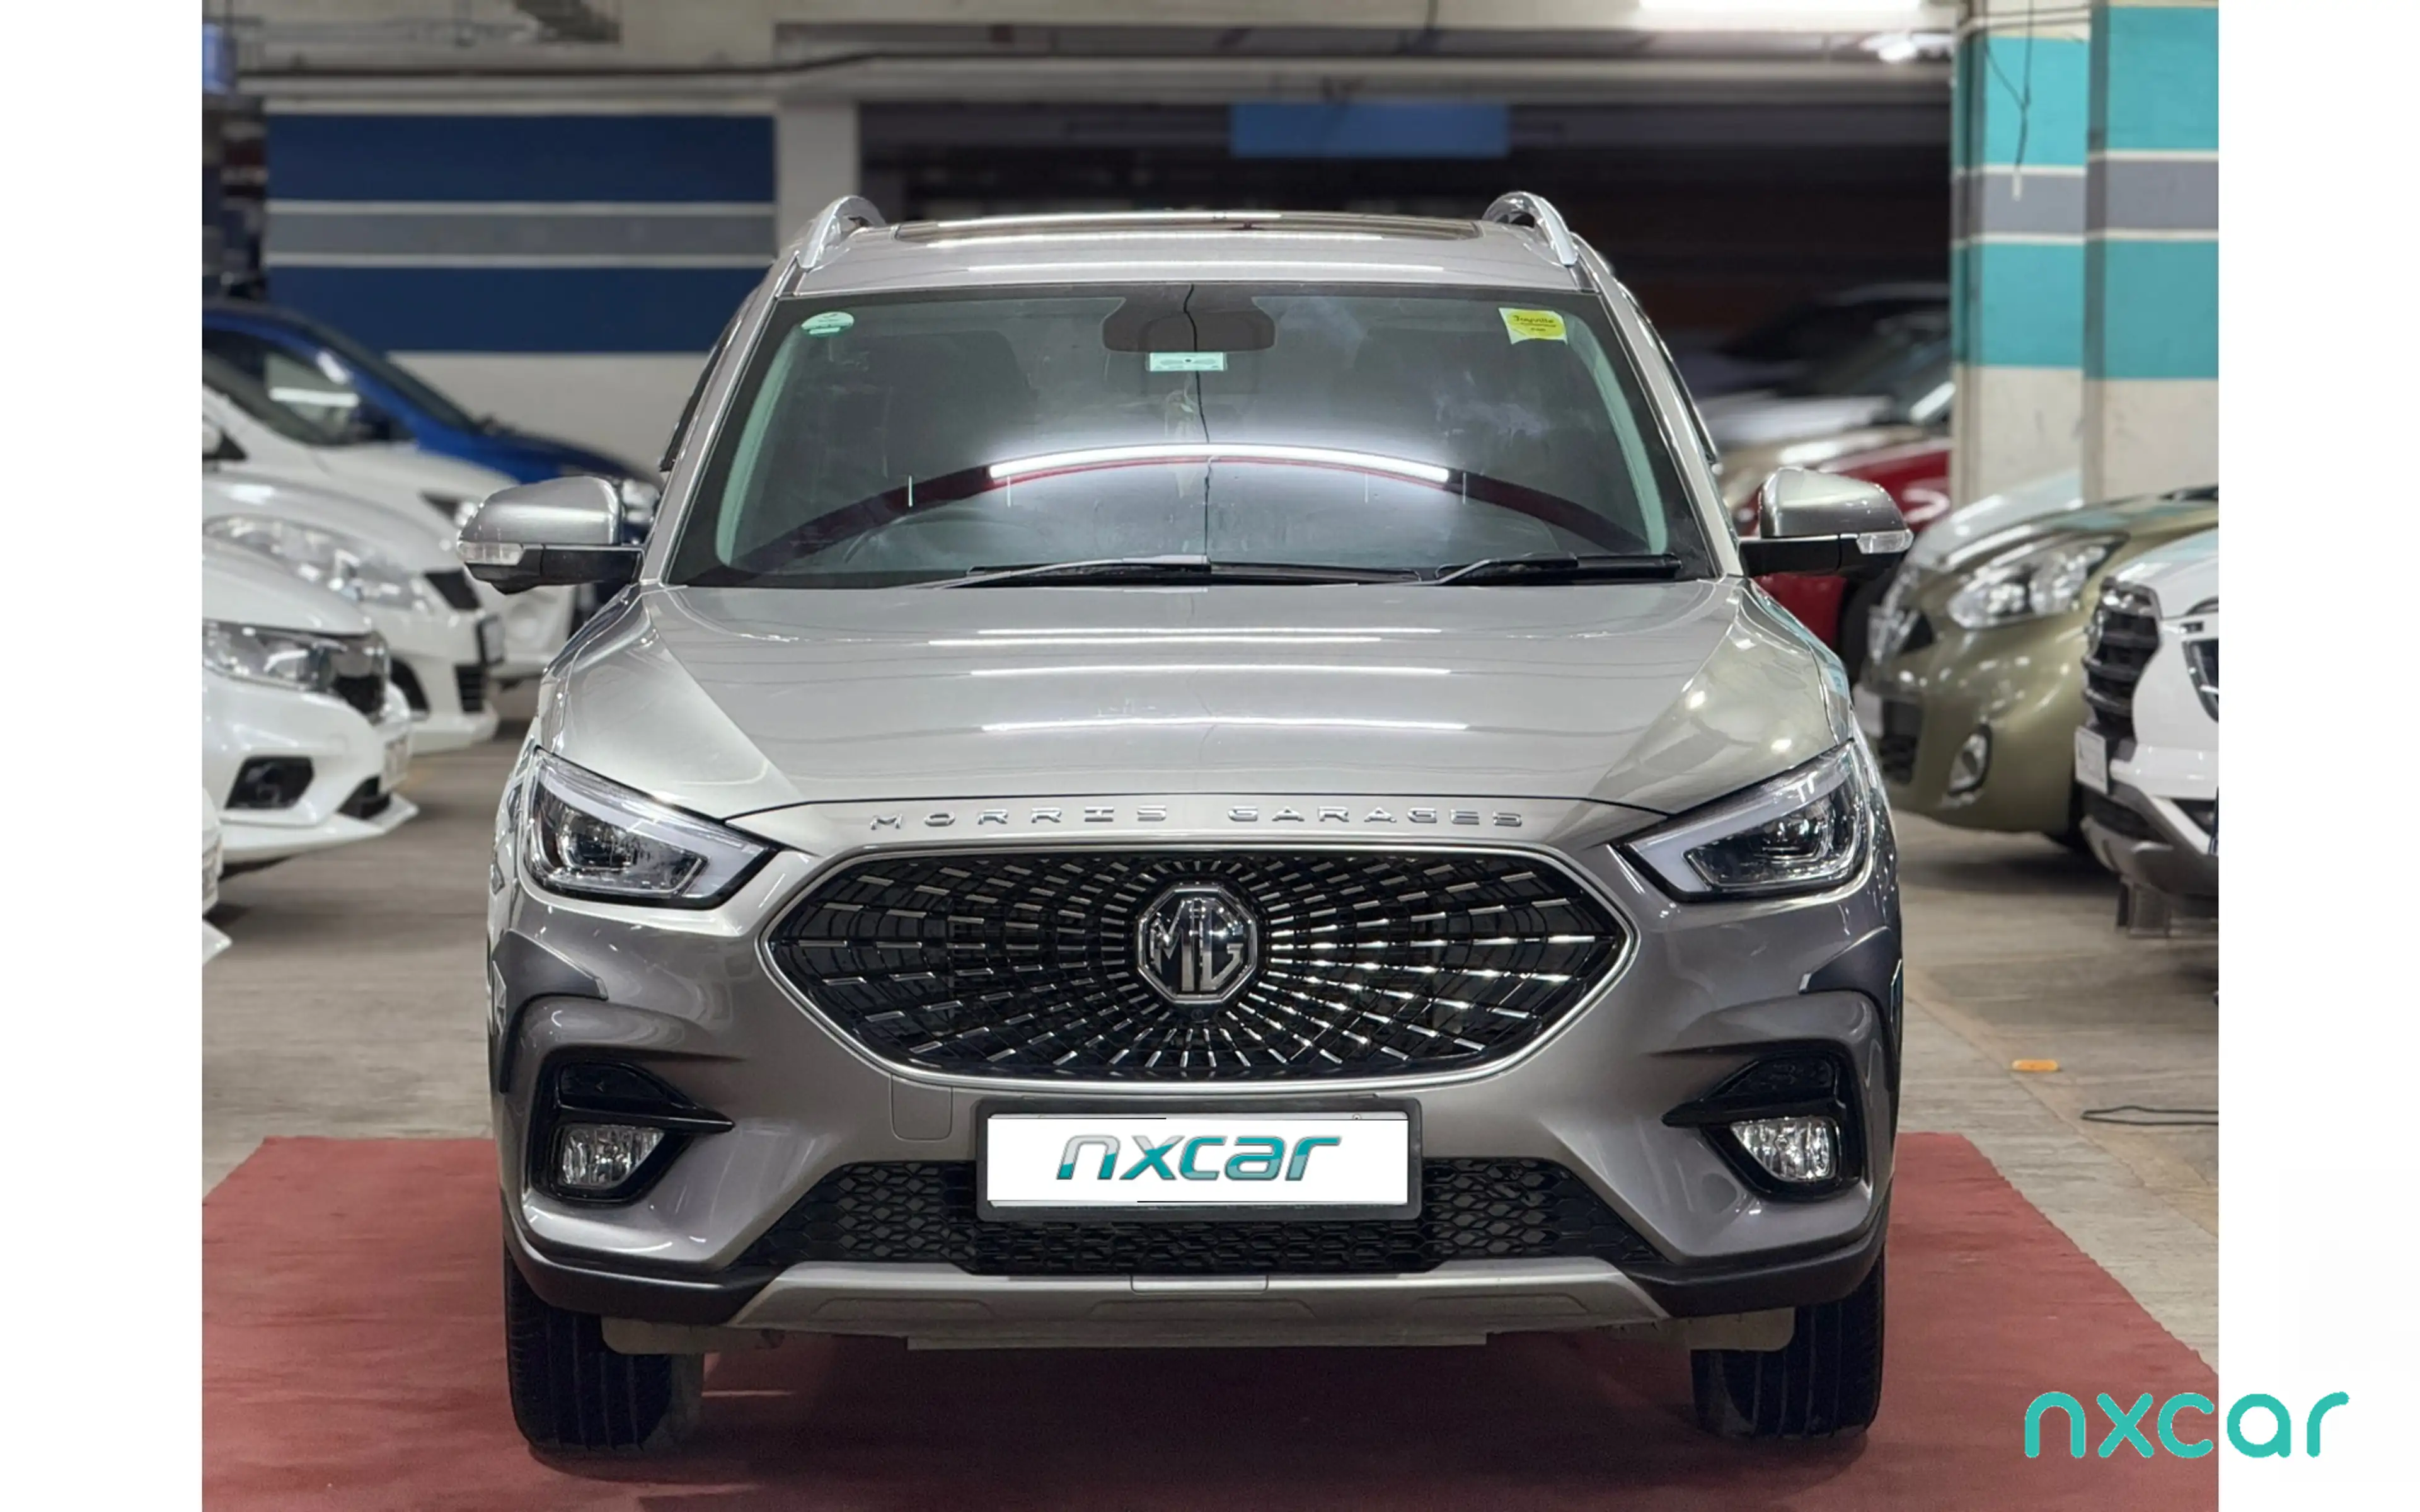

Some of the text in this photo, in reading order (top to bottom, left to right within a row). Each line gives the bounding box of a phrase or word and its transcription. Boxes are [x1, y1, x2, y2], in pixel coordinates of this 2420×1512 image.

[870, 805, 1522, 830] MORRIS GARAGES
[1150, 898, 1244, 991] MG
